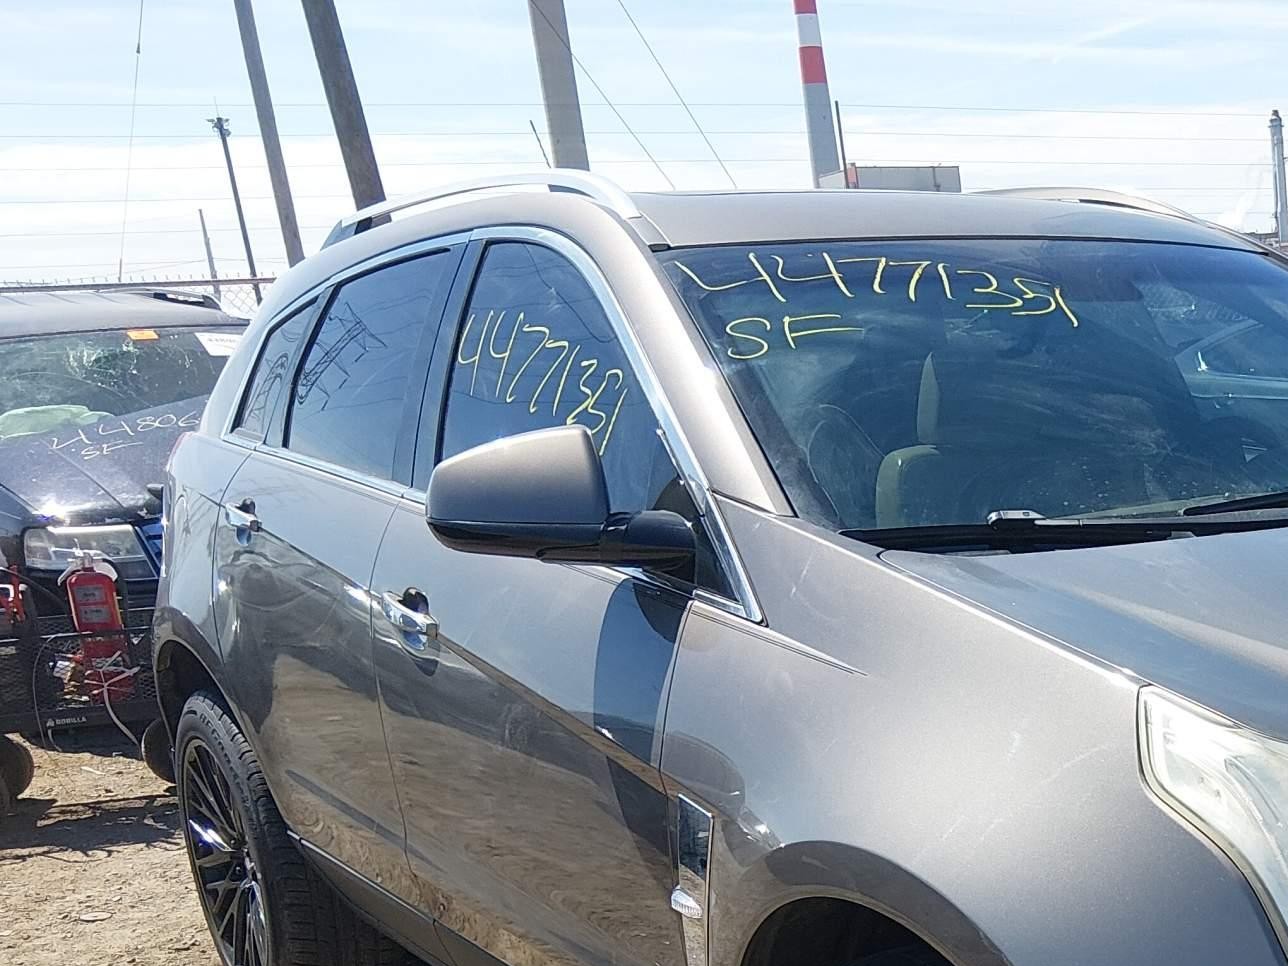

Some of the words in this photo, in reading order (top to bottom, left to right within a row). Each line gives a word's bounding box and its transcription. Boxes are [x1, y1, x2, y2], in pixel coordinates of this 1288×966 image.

[675, 251, 1079, 328] 44771351
[725, 312, 865, 361] SF
[457, 308, 629, 457] 44771351
